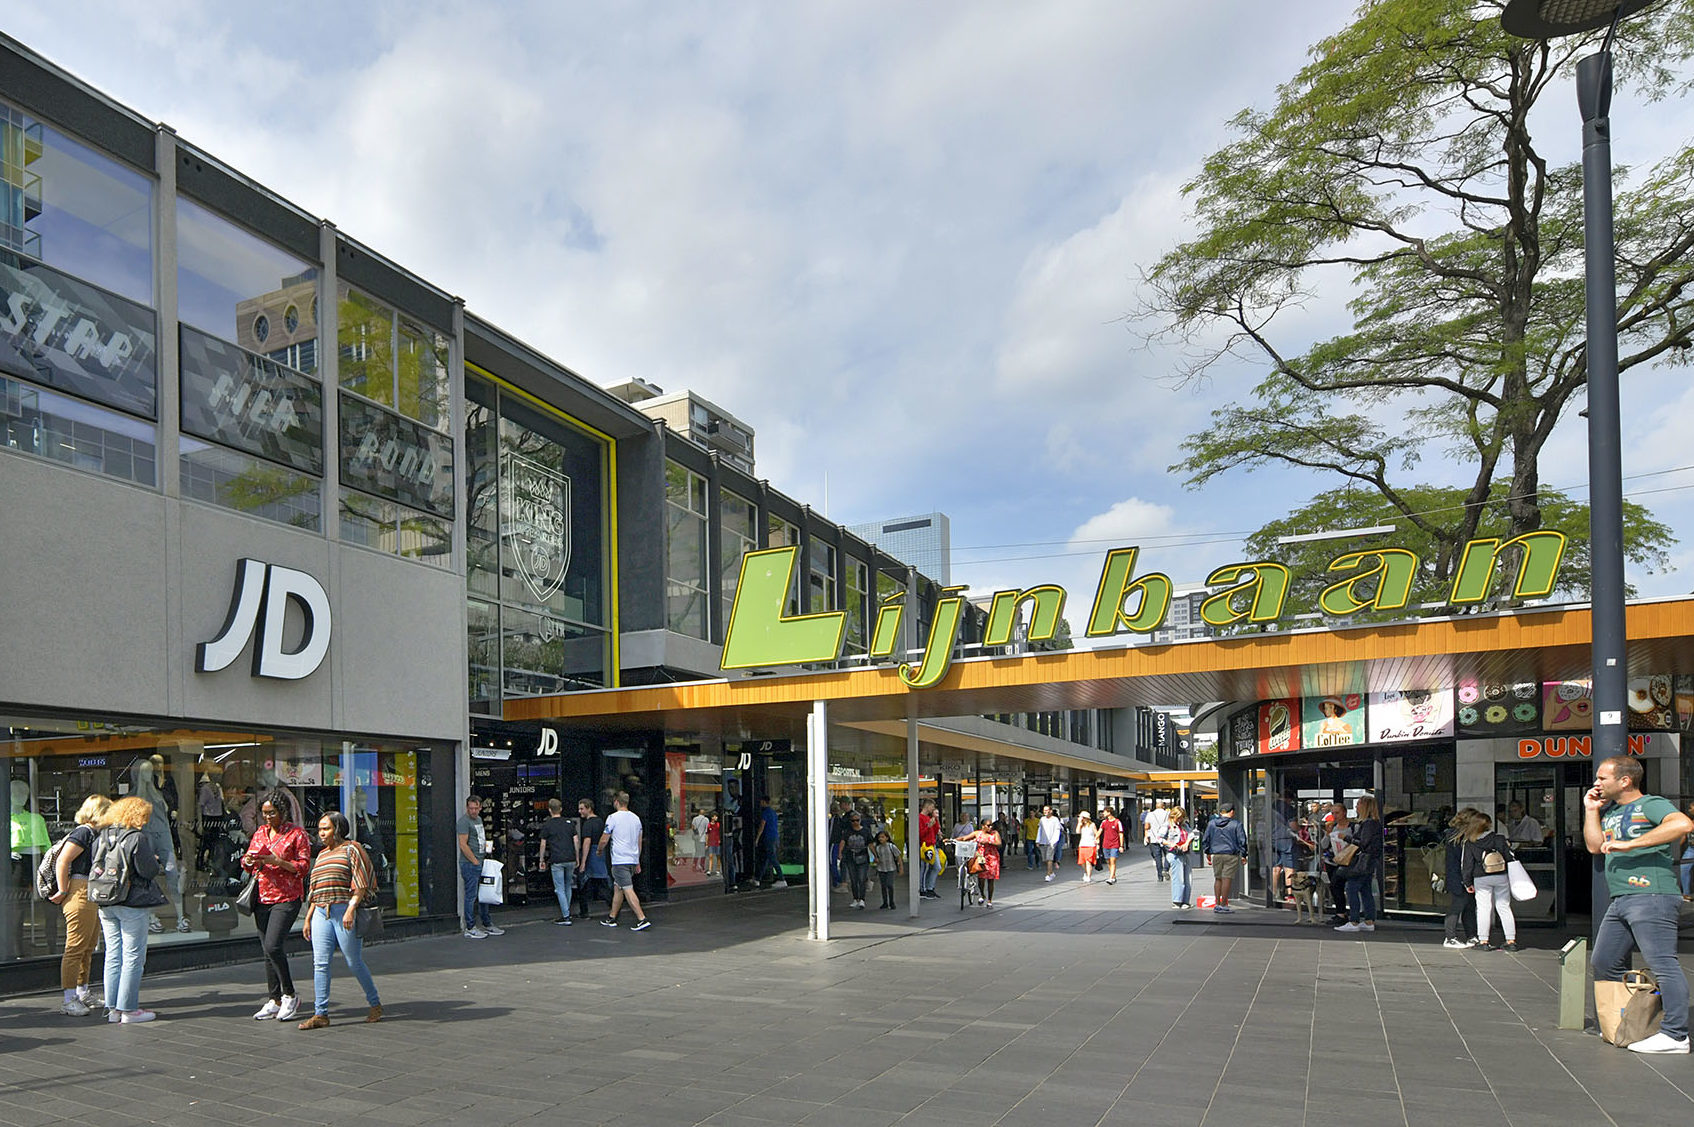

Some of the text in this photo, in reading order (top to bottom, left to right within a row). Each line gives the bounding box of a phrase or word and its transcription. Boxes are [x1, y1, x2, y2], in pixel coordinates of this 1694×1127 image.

[195, 557, 333, 680] JD
[719, 529, 1568, 689] Lijnbaan
[1157, 713, 1165, 747] MANGO
[1316, 733, 1351, 747] Coffee
[537, 728, 559, 756] JD
[760, 741, 773, 751] JD
[1518, 735, 1651, 759] DUNN'
[738, 752, 751, 770] JD
[508, 786, 536, 794] JUNIORS
[207, 902, 230, 912] FILA
